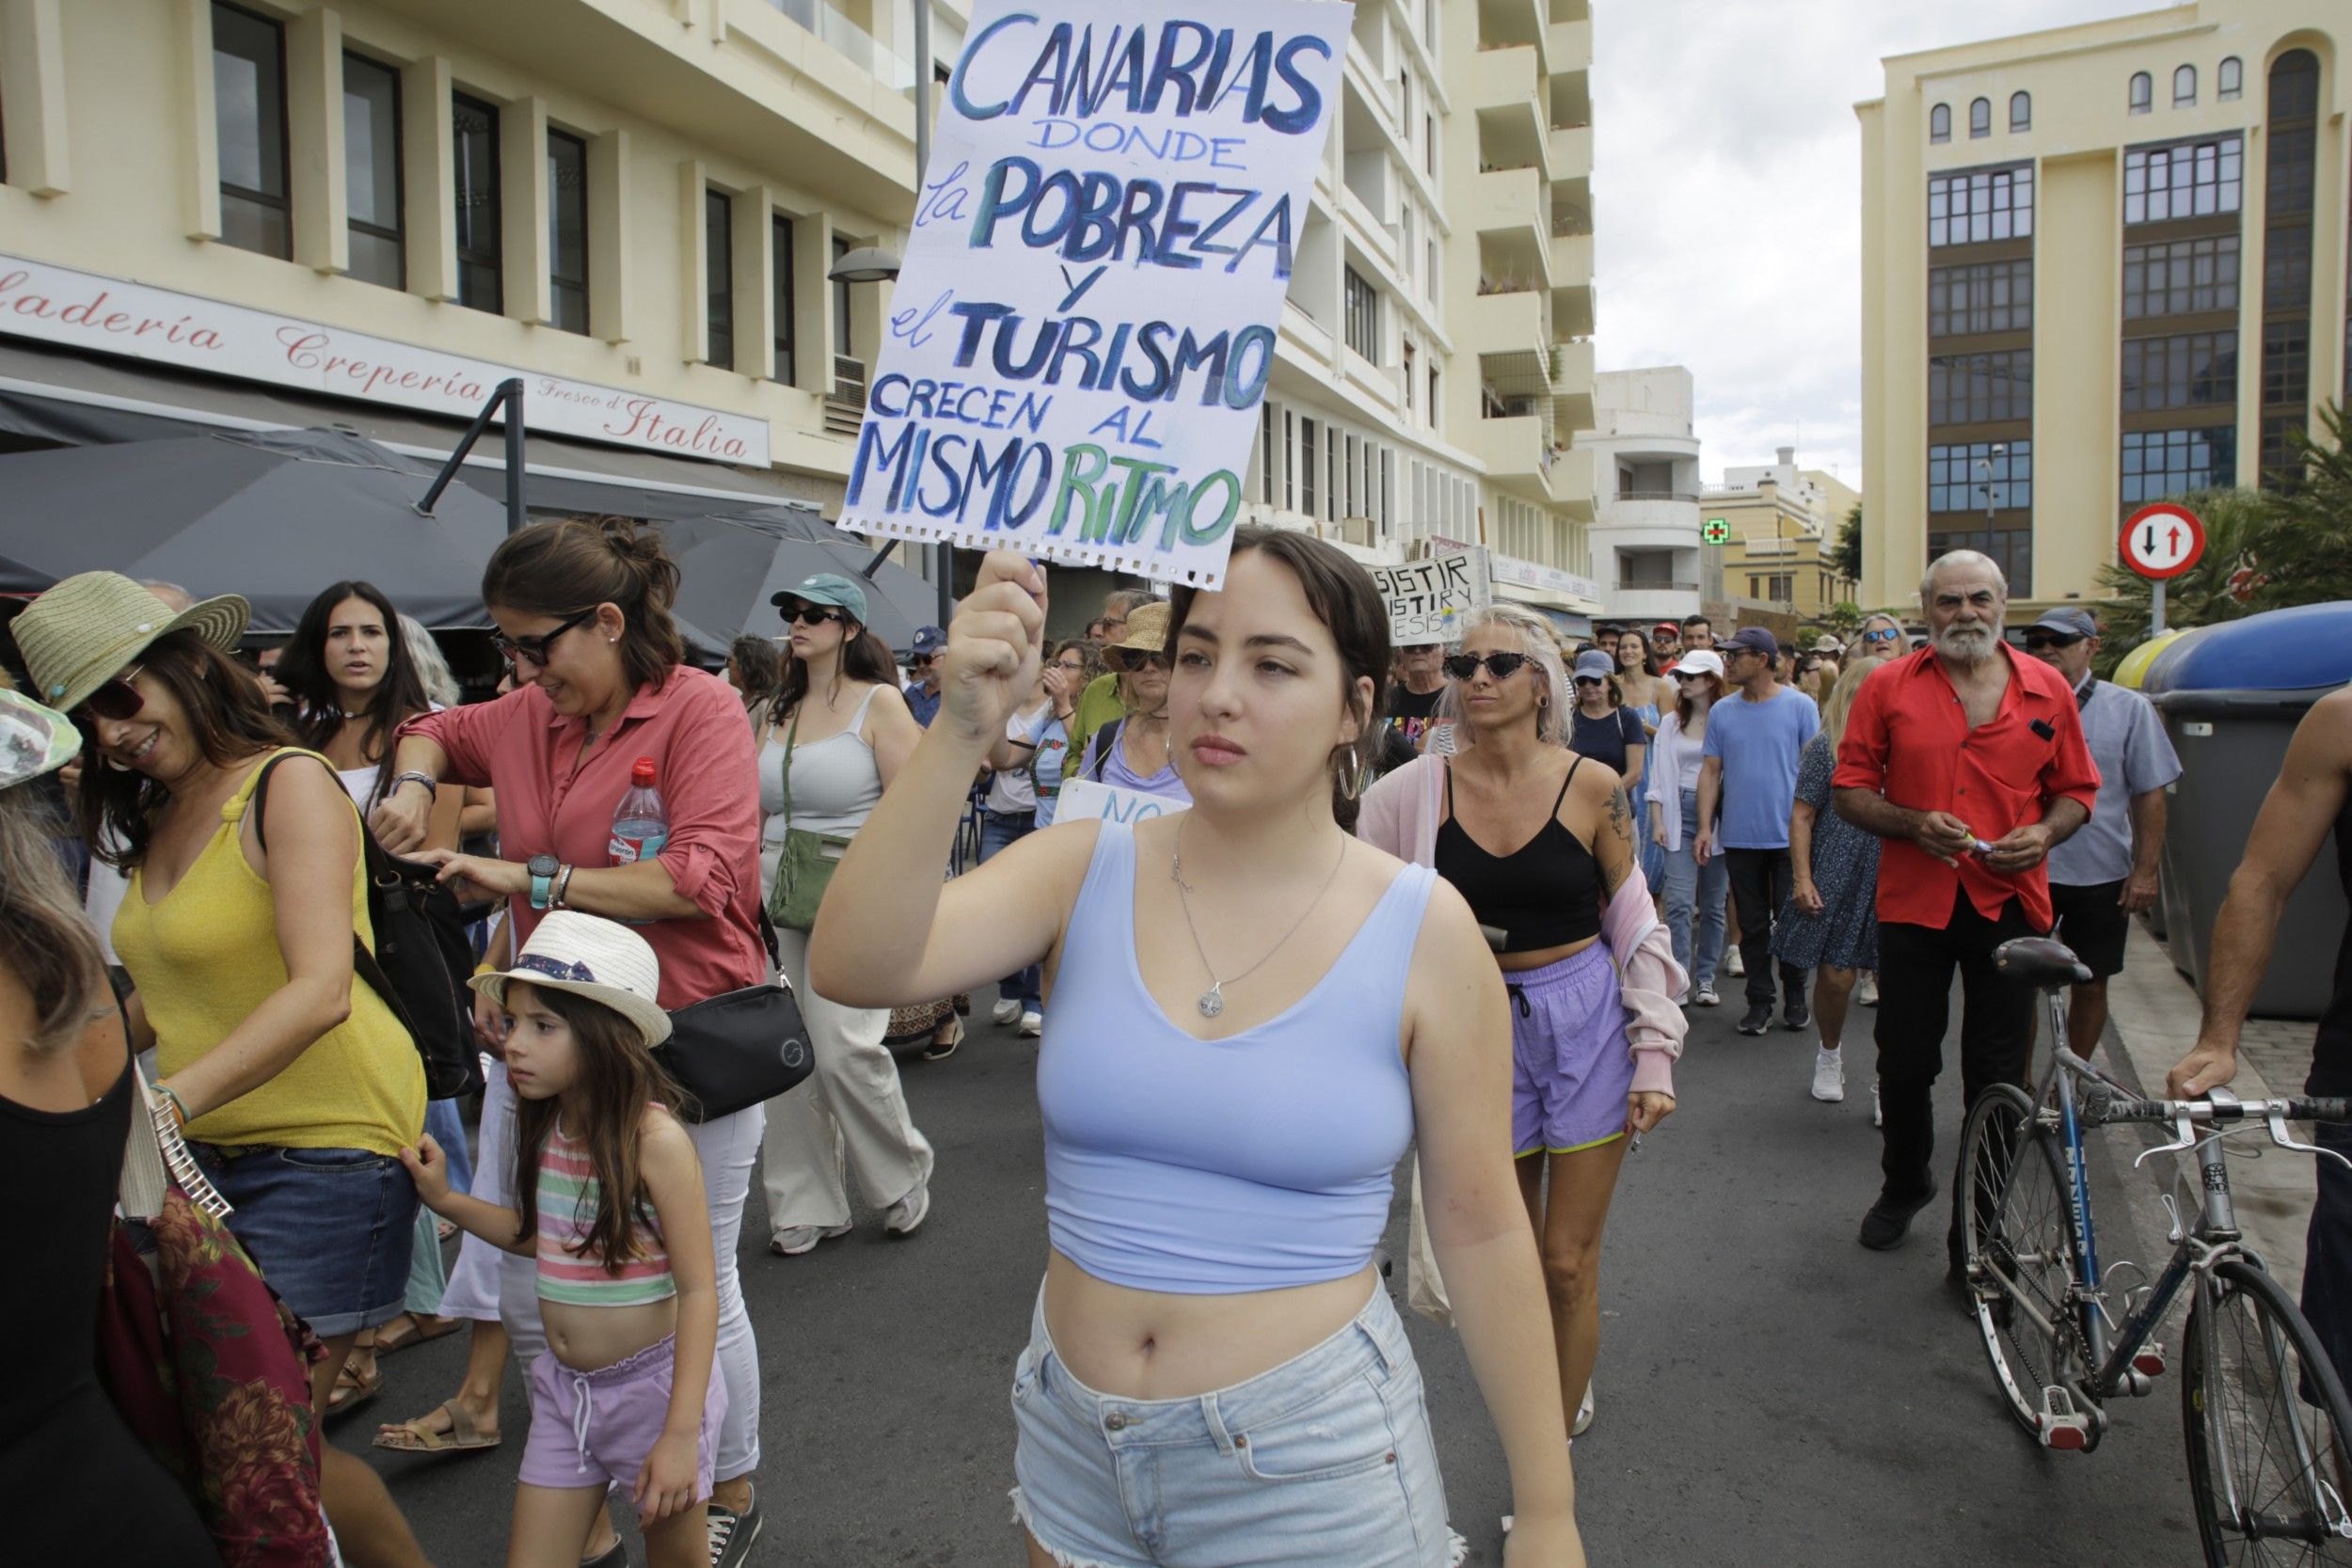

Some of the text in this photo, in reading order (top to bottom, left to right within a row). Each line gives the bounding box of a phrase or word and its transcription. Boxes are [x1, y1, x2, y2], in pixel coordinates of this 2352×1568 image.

[950, 13, 1332, 135] CANARIAS
[1025, 119, 1248, 171] DONDE
[915, 156, 1292, 280] la POBREZA
[1059, 263, 1109, 313] Y
[276, 325, 485, 402] Crepería
[891, 289, 1278, 411] el TURISMO
[537, 378, 600, 406] Fresco
[869, 372, 1164, 449] CRECEN AL
[848, 421, 1053, 530] MISMO
